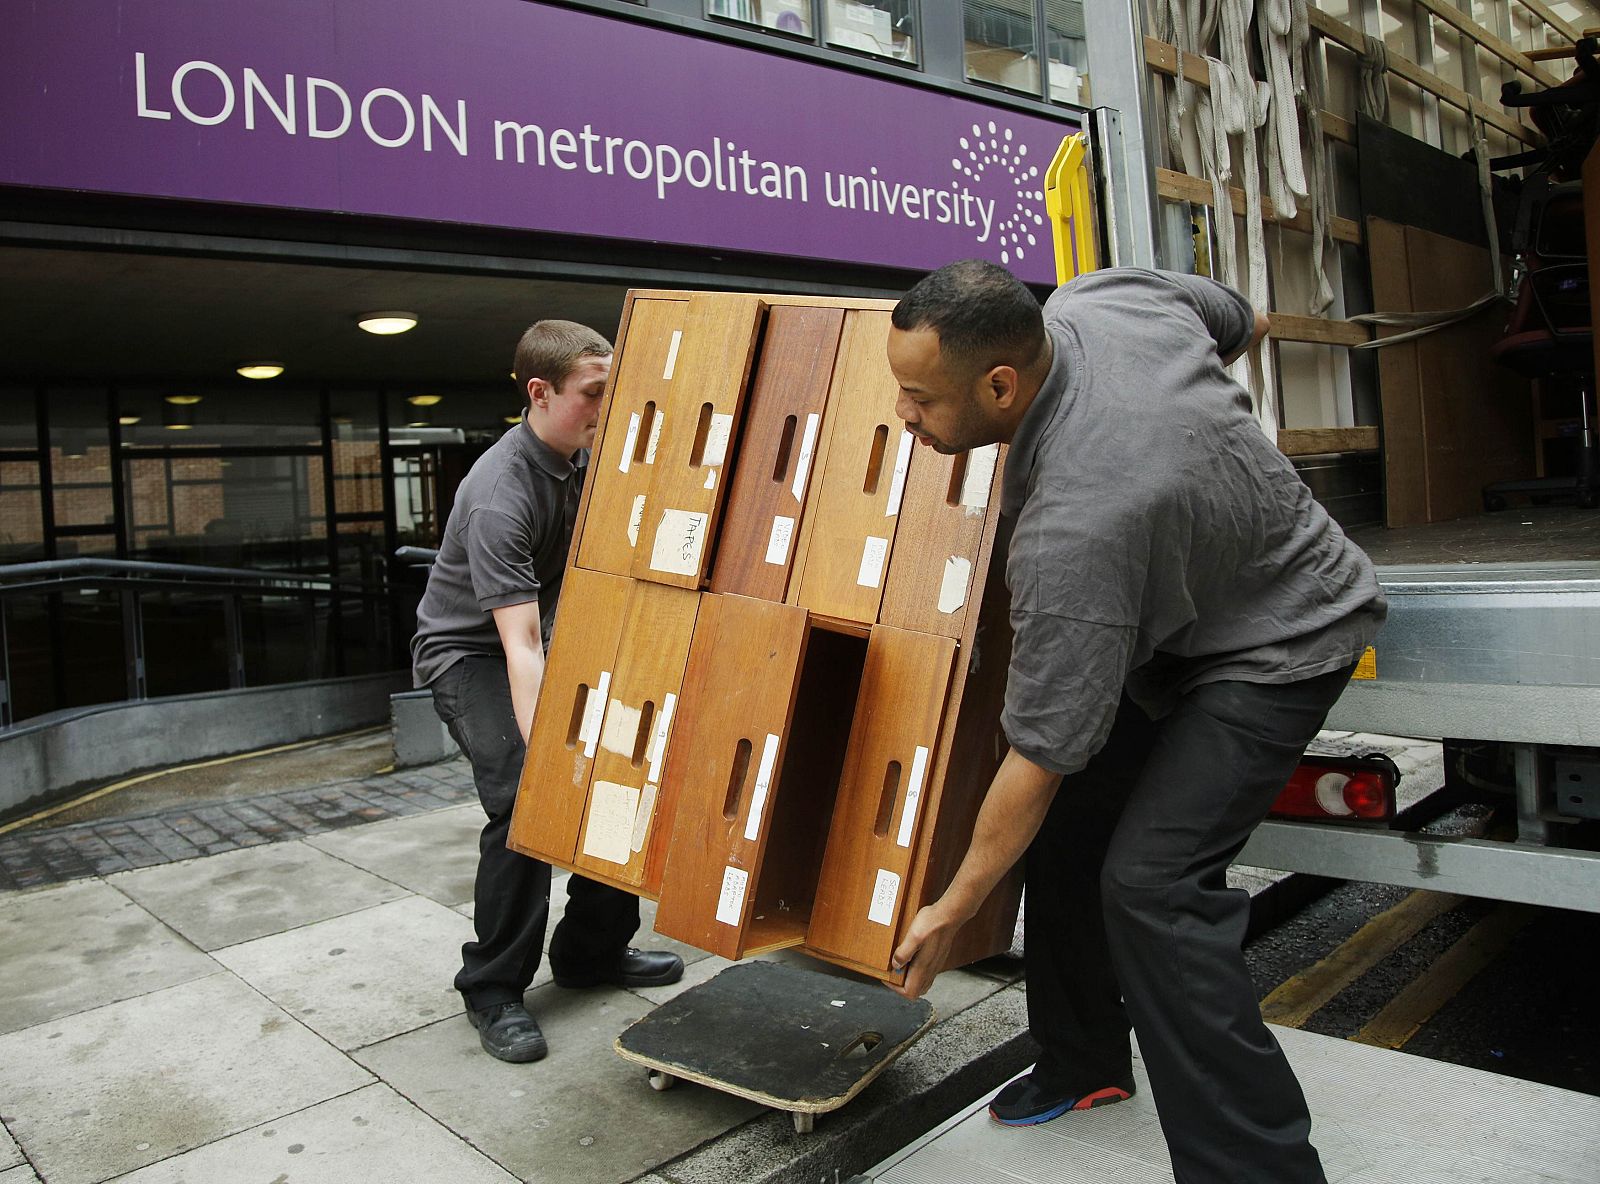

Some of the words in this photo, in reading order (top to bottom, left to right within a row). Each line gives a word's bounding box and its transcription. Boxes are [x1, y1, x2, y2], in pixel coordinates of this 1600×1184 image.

[135, 52, 468, 156] LONDON
[494, 120, 808, 200] metropolitan
[824, 166, 995, 243] university
[682, 517, 702, 561] TAPES
[908, 790, 918, 798] 8
[886, 879, 897, 909] SCART
